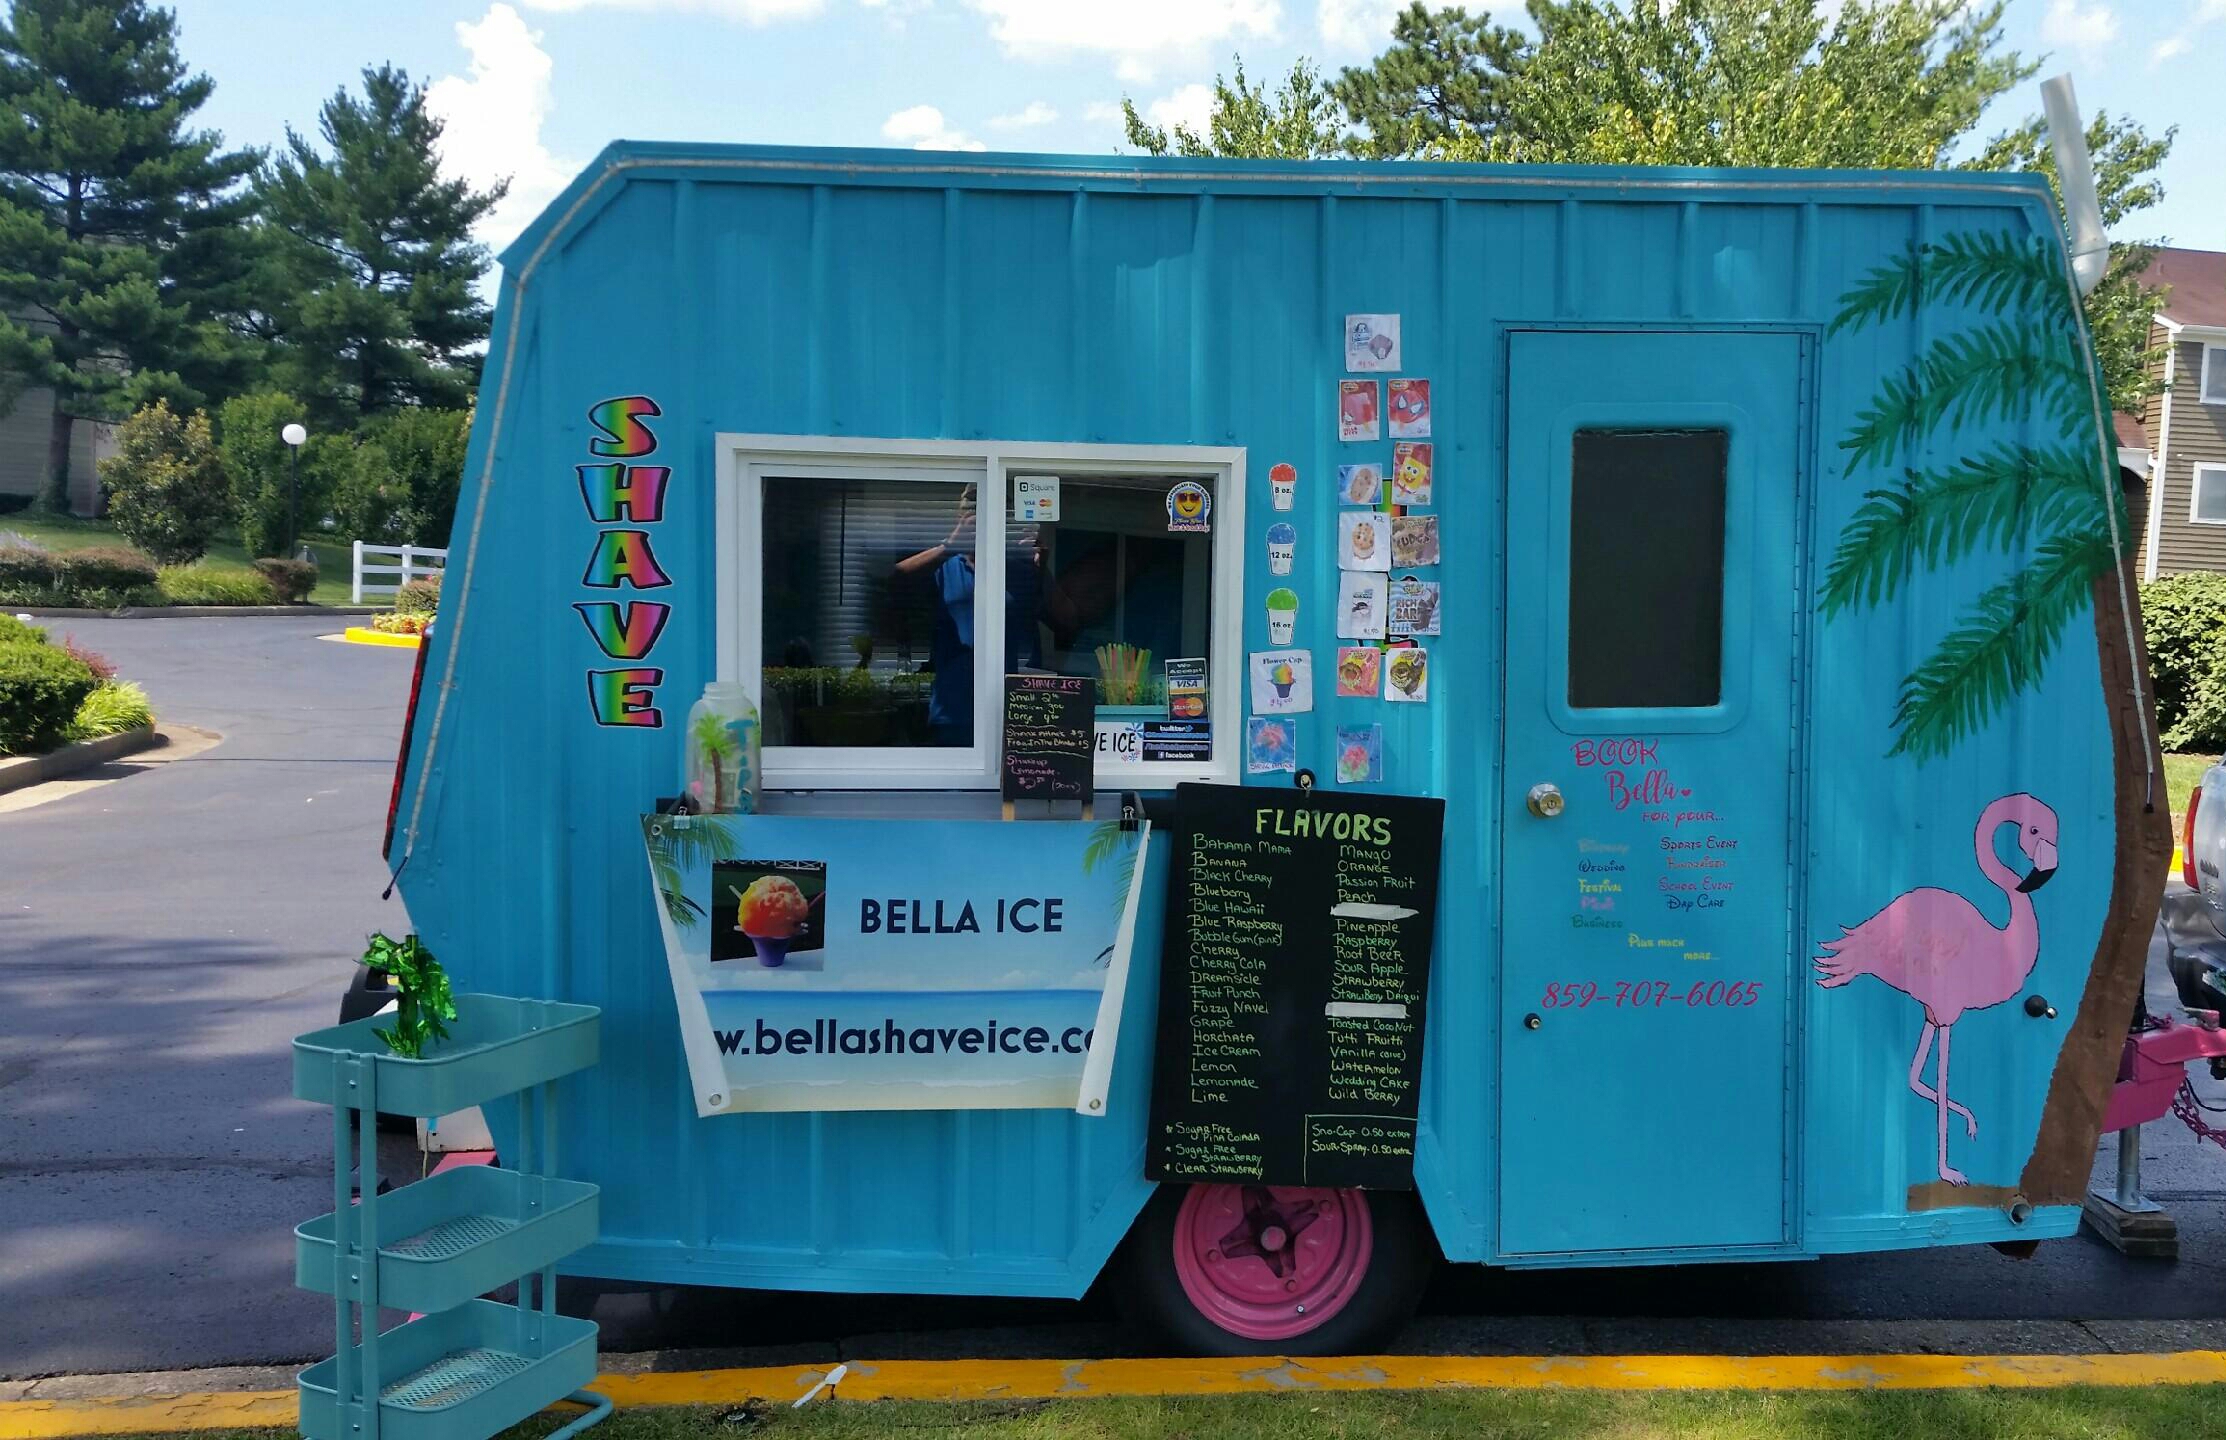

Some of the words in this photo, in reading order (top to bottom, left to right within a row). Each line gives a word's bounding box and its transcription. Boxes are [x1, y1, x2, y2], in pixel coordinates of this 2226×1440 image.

[1030, 483, 1056, 492] Square
[572, 396, 672, 728] SHAVE
[1396, 608, 1418, 620] BAR
[1060, 680, 1083, 690] ICE
[1176, 680, 1198, 688] VISA
[1009, 691, 1035, 703] Small
[1008, 711, 1033, 724] Large
[1112, 732, 1136, 752] ICE
[1571, 738, 1658, 766] BOOK
[1605, 769, 1678, 810] Bella
[1256, 808, 1392, 846] FLAVORS
[1189, 882, 1251, 905] Blueberry
[860, 898, 981, 934] BELLA
[996, 898, 1063, 933] ICE
[1541, 980, 1763, 1009] 859-707-6065
[1191, 1057, 1237, 1073] Lemon
[1191, 1088, 1229, 1103] Lime
